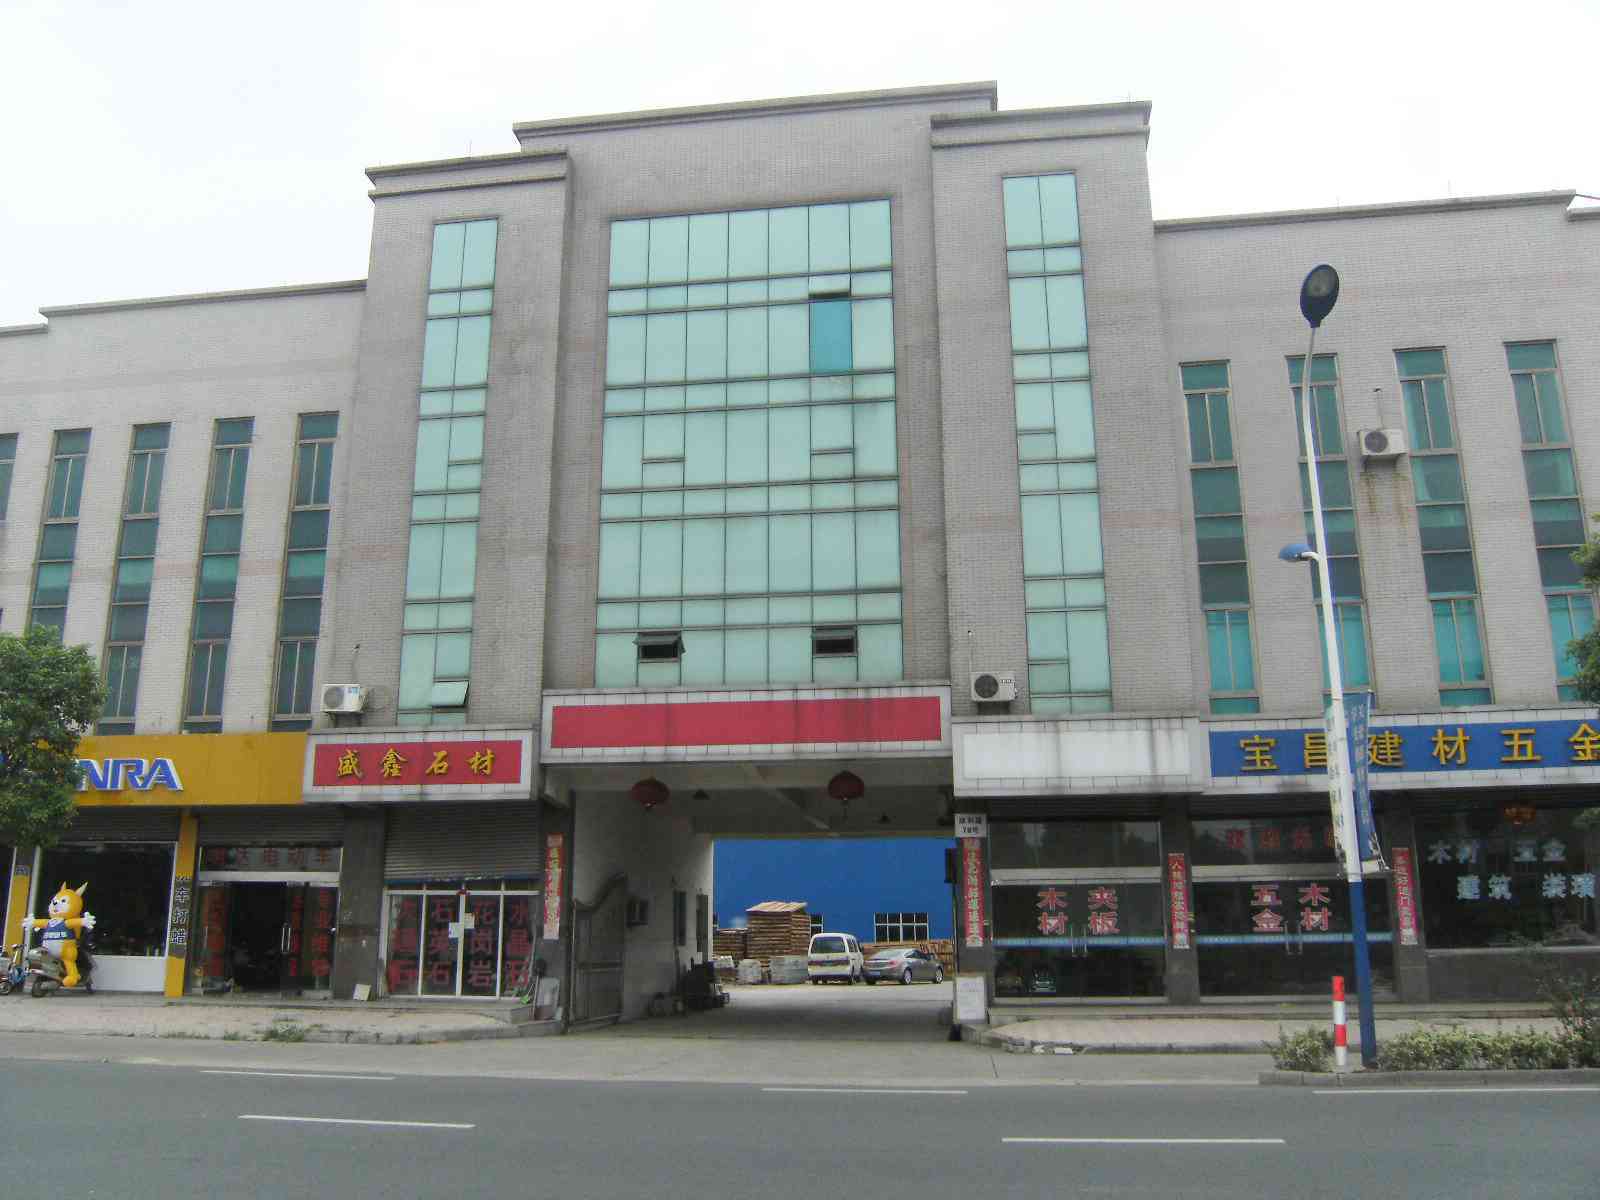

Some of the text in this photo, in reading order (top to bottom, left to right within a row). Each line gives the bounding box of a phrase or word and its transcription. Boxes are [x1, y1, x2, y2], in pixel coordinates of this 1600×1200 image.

[336, 748, 497, 779] 盛鑫石材
[1239, 722, 1600, 772] 宝昌建材五金
[1427, 838, 1567, 864] 木材 五金
[1037, 887, 1068, 935] 木材
[1087, 886, 1120, 935] 夹板
[1251, 884, 1283, 932] 五金
[1298, 883, 1332, 931] 木材
